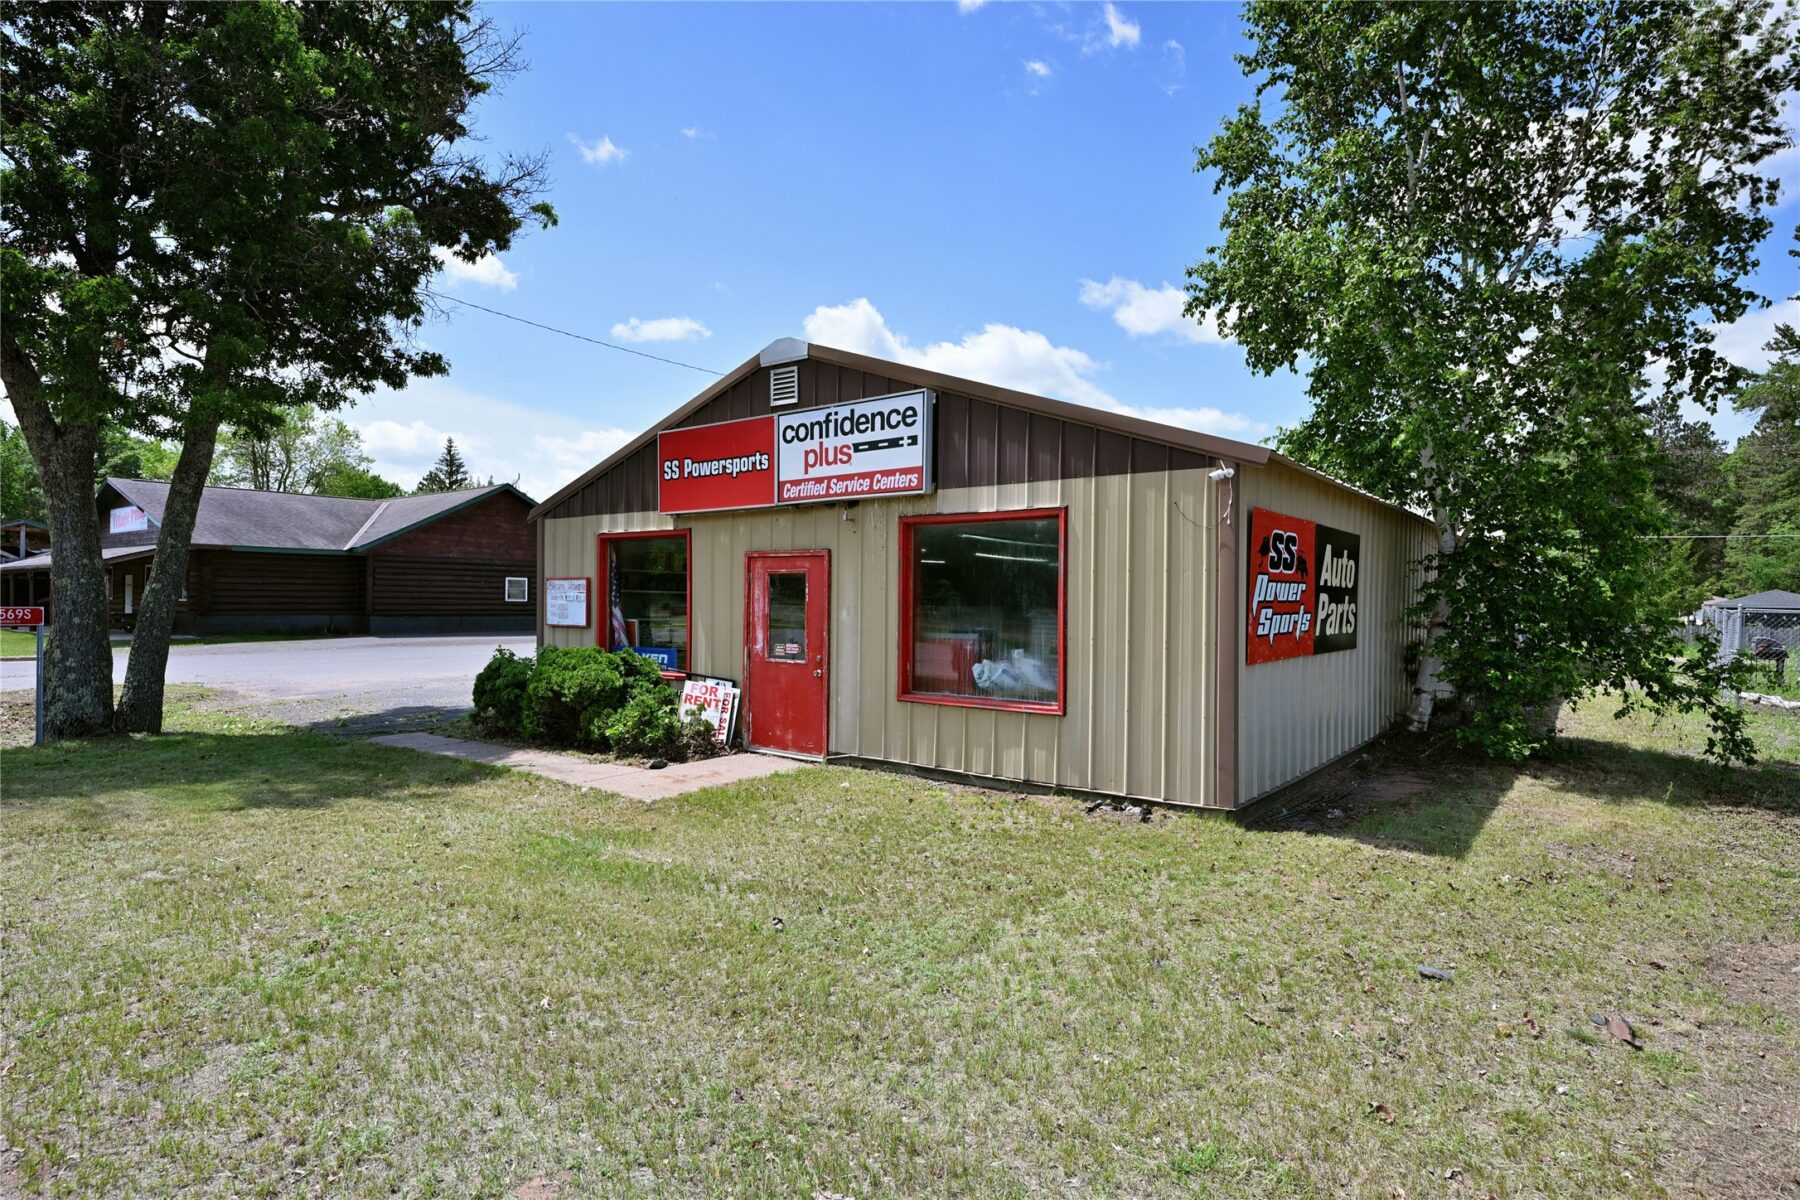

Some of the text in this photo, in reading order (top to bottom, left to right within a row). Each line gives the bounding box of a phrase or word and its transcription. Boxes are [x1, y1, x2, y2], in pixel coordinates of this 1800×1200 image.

[782, 405, 918, 444] confidence
[663, 452, 769, 480] SS Powersports
[803, 442, 853, 475] plus
[783, 473, 919, 499] Certified Service Centers
[1267, 529, 1298, 574] SS
[1319, 544, 1356, 589] Auto
[1252, 573, 1307, 618] Power
[1256, 605, 1312, 646] Sports
[1315, 593, 1357, 636] Parts
[683, 693, 722, 710] RENT
[690, 682, 719, 698] FOR
[721, 692, 731, 714] FOR
